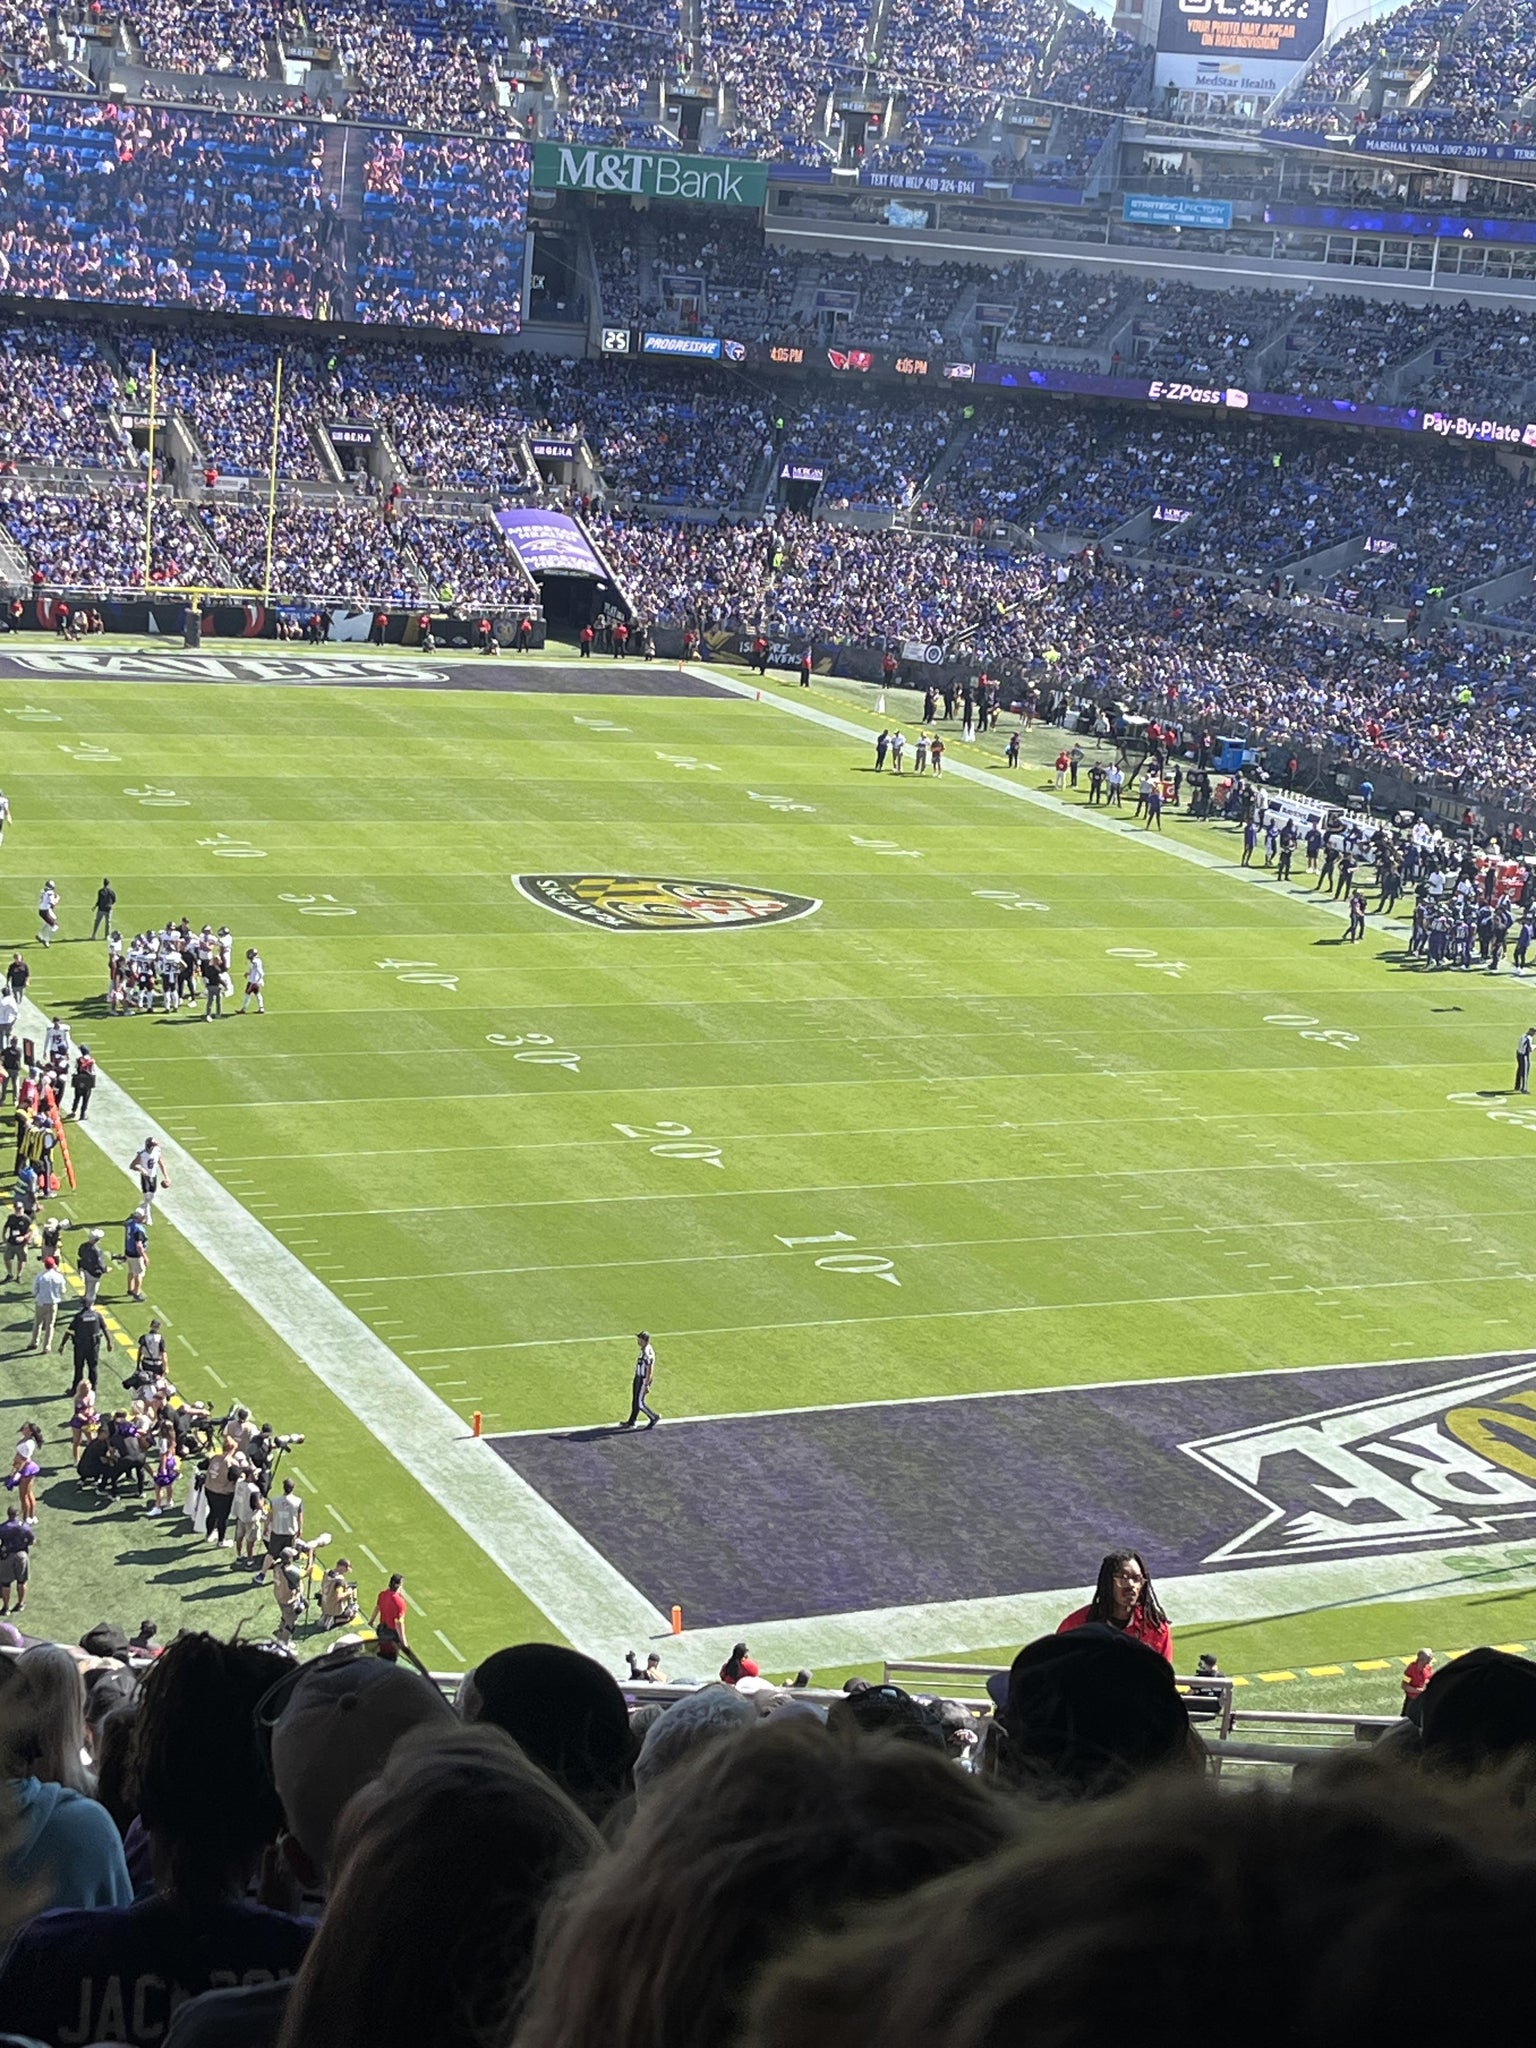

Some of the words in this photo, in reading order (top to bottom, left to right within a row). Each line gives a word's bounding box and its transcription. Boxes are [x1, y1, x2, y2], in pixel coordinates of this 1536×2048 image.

[1187, 19, 1211, 33] YOUR
[1211, 20, 1240, 36] PHOTO
[1241, 22, 1261, 36] MAY
[1261, 23, 1296, 38] APPEAR
[1201, 33, 1214, 46] ON
[1196, 75, 1238, 88] MedStar
[1241, 78, 1276, 90] Health
[1365, 140, 1408, 153] MARSHAL
[1410, 143, 1440, 154] YANDA
[1441, 144, 1488, 157] 2007-2019
[1514, 149, 1536, 160] TERR
[556, 147, 653, 193] M&T
[656, 157, 743, 202] Bank
[870, 173, 888, 187] TEXT
[889, 174, 904, 188] FOR
[905, 176, 924, 190] HELP
[605, 331, 626, 350] 25
[644, 337, 718, 354] PROGRESSIVE
[789, 348, 804, 363] PM
[913, 360, 928, 374] PM
[1148, 381, 1221, 404] E-ZPass
[1423, 413, 1522, 442] Pay-By-Plate
[10, 654, 449, 685] RAVENS
[123, 786, 191, 807] 30
[196, 837, 268, 857] 40
[277, 893, 357, 916] 50
[536, 879, 631, 927] RAVENS
[970, 890, 1050, 911] 50
[1105, 947, 1191, 971] 40
[374, 957, 460, 983] 40
[1262, 1014, 1360, 1042] 30
[485, 1033, 581, 1064] 30
[611, 1121, 722, 1158] 20
[773, 1231, 895, 1274] 10
